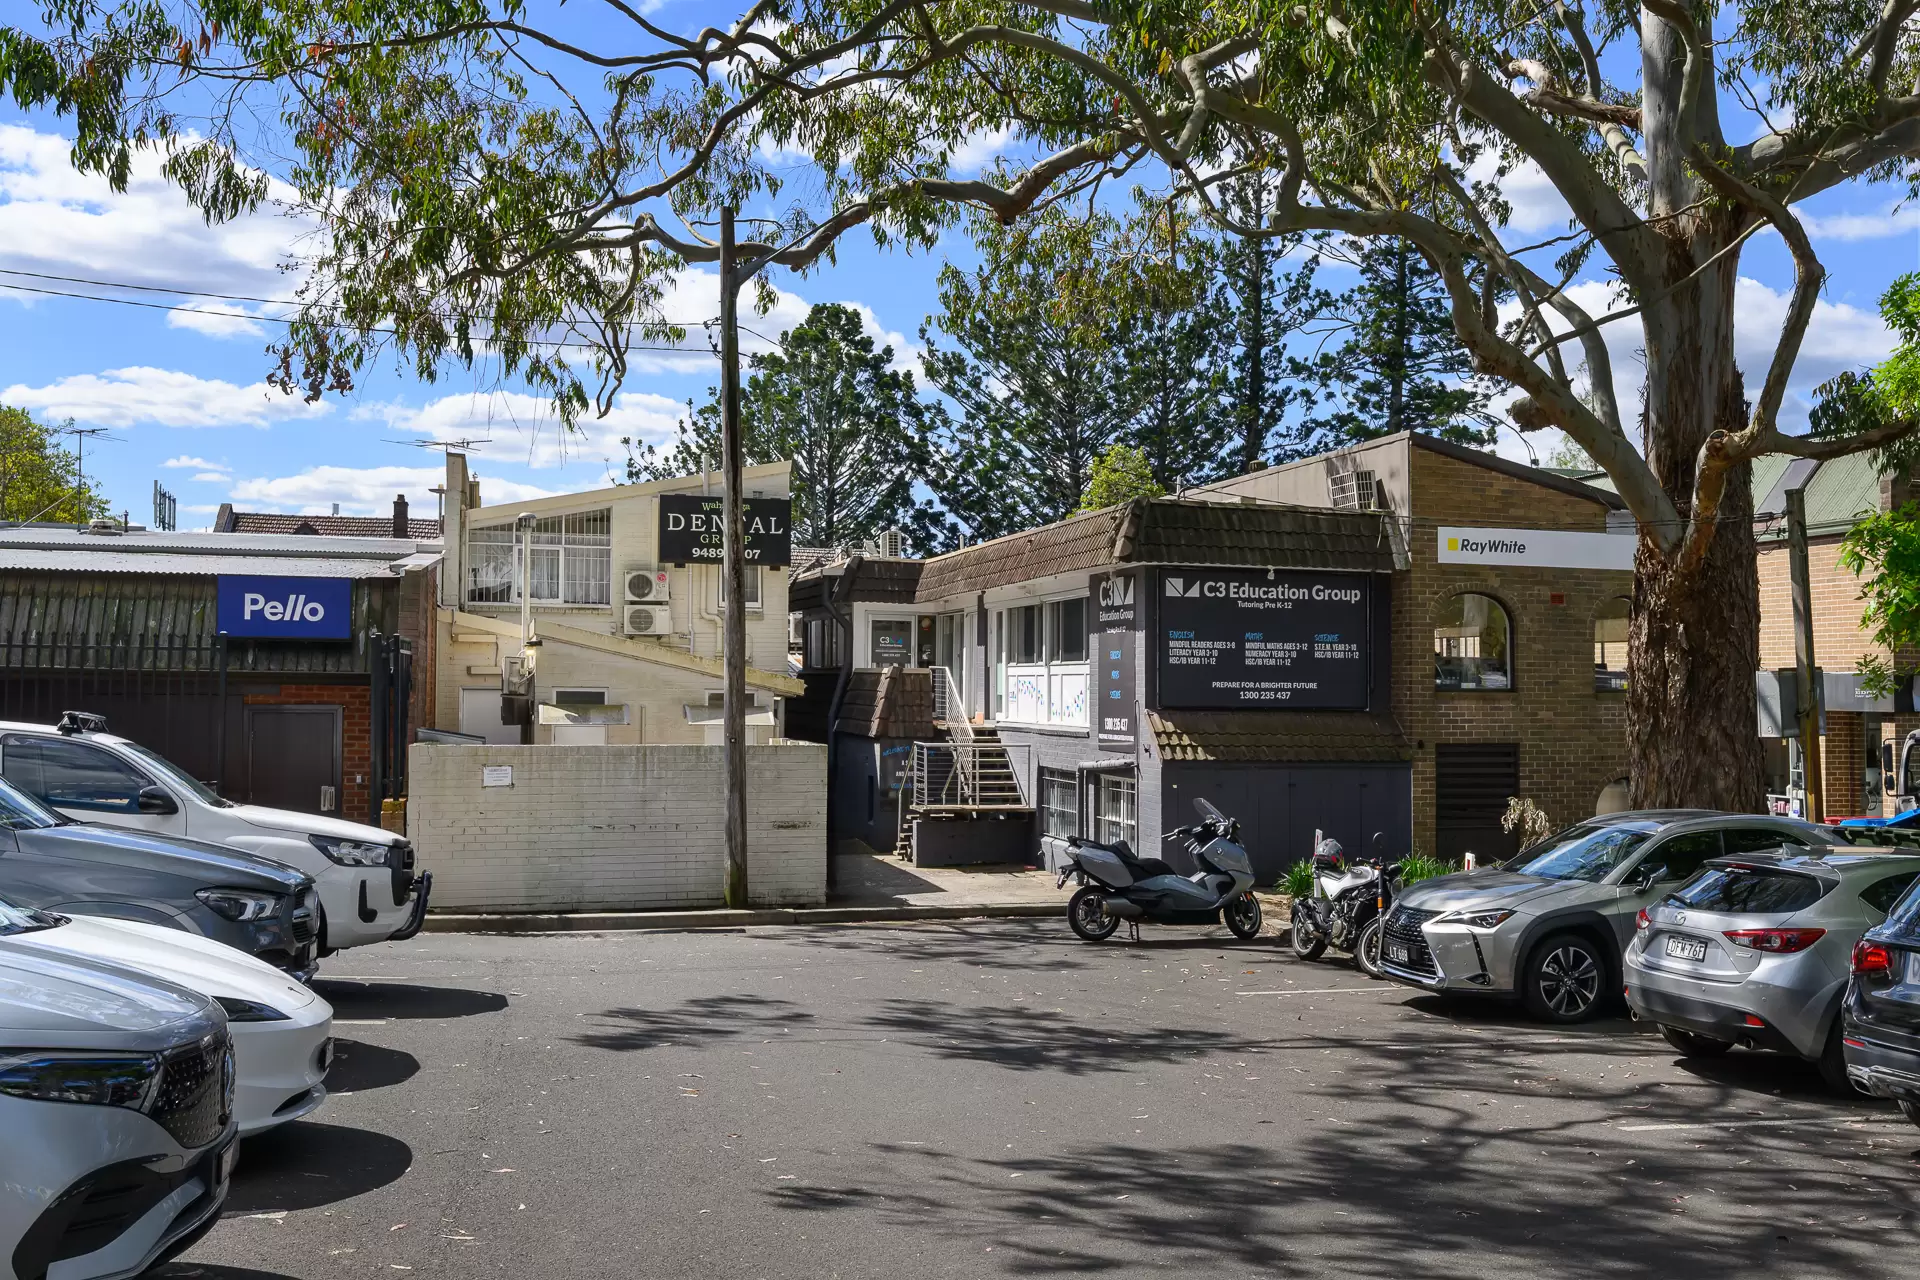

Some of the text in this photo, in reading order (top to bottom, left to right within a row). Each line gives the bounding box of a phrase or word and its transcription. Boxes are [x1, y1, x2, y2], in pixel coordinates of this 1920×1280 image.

[667, 513, 784, 534] DENAL
[700, 534, 752, 544] GRP
[1100, 580, 1113, 606] C3
[1204, 582, 1360, 604] C3 Education Group
[244, 593, 324, 622] Pello
[1100, 609, 1134, 621] Education Group
[1237, 600, 1264, 609] Tutoring
